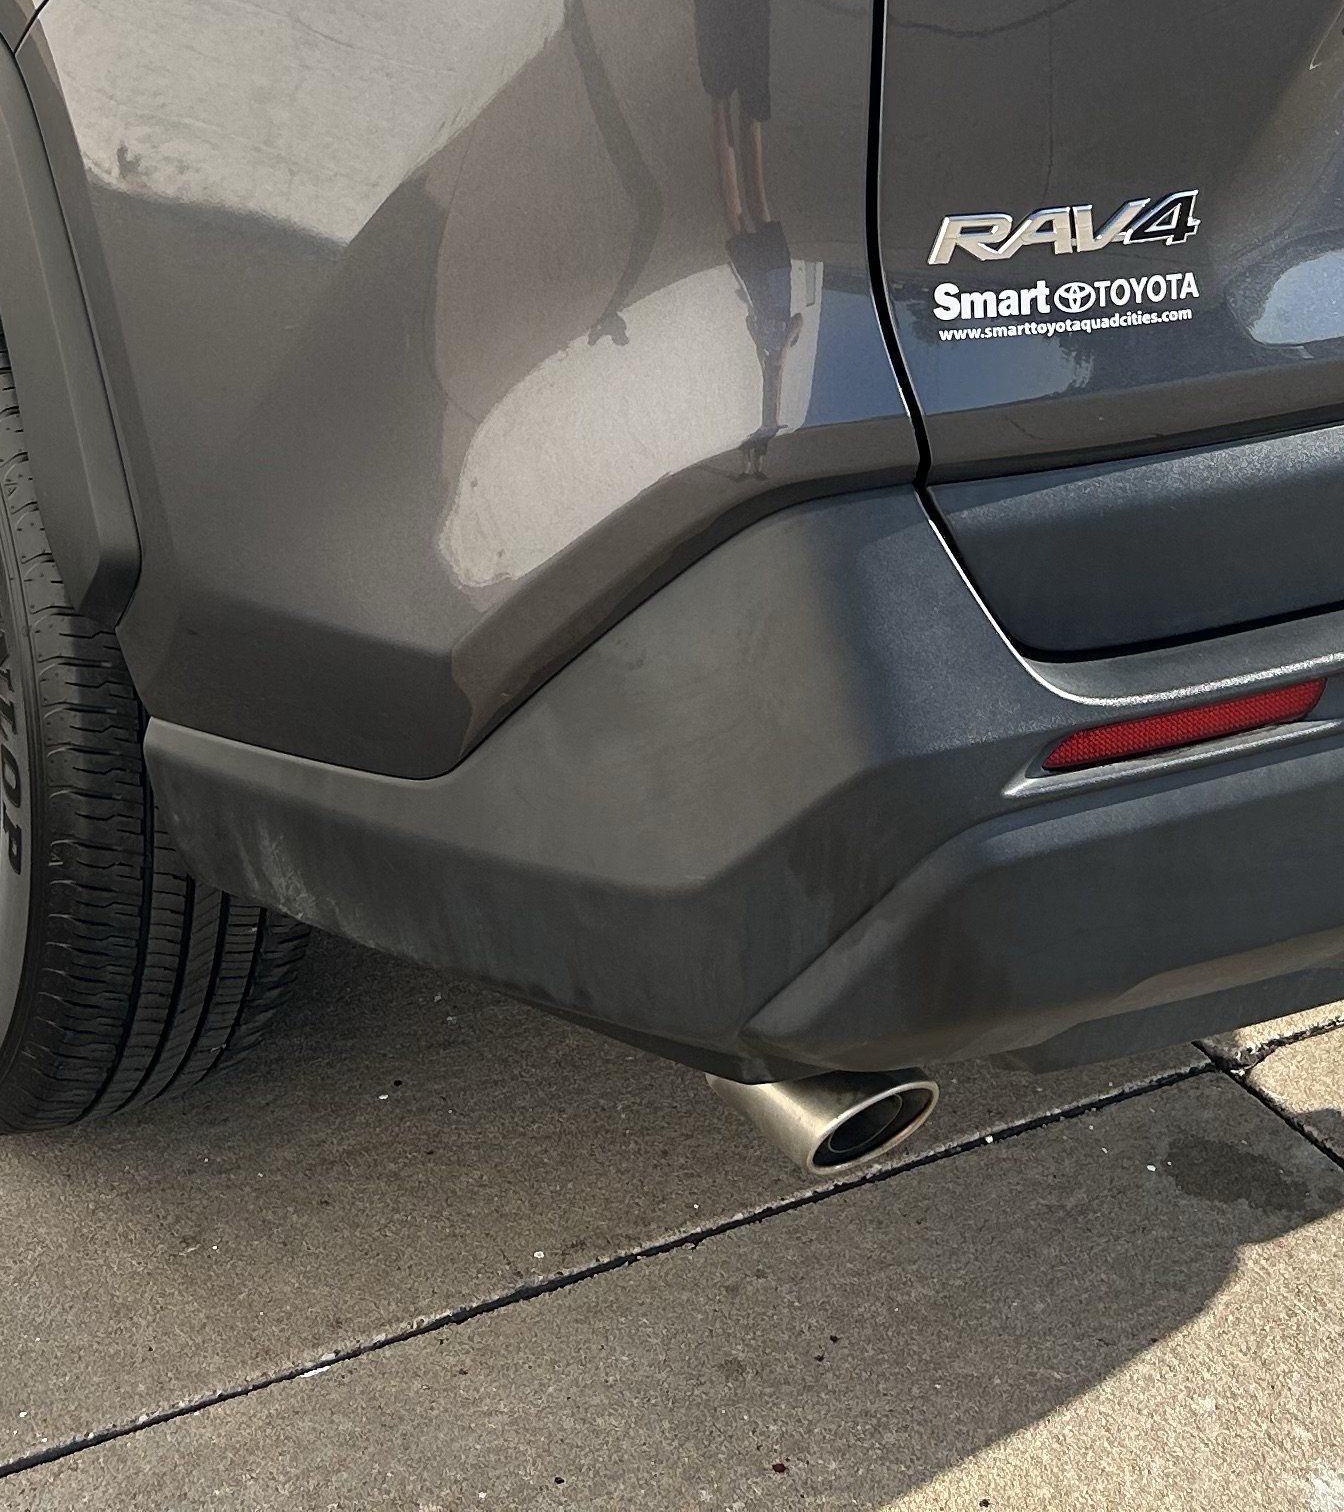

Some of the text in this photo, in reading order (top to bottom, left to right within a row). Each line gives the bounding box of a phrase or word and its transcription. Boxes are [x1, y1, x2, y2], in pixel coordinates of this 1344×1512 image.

[927, 189, 1202, 265] RAV4
[933, 272, 1200, 321] Smart TOYOTA
[938, 308, 1193, 341] www.smarttoyotaquadcities.com
